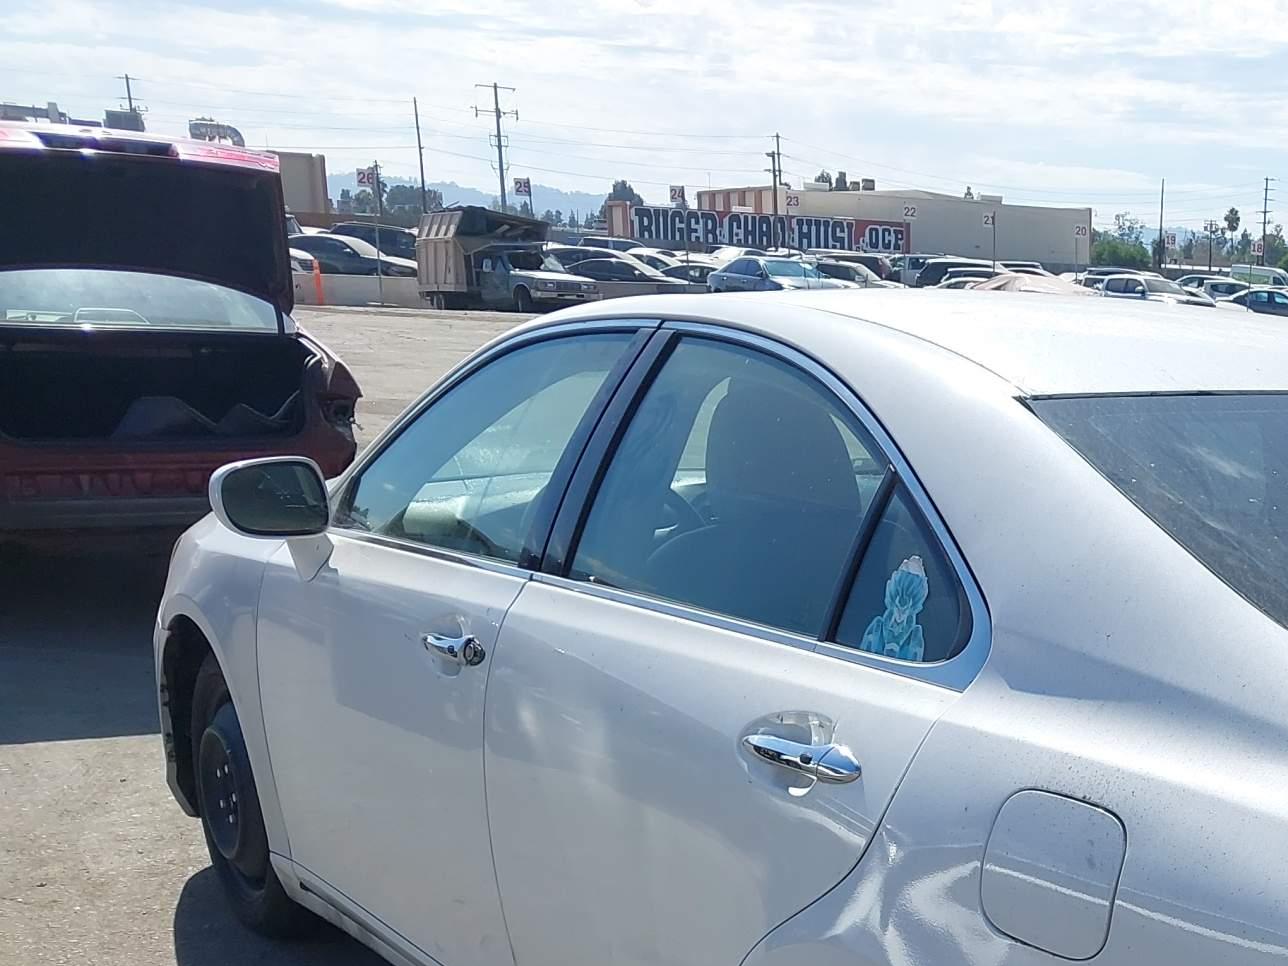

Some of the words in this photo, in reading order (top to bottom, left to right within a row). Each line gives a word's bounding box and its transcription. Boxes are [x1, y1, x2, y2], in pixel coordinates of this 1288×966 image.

[357, 171, 375, 184] 26
[515, 181, 531, 193] 25
[670, 188, 685, 200] 24
[786, 196, 800, 207] 23
[904, 206, 917, 217] 22
[984, 215, 995, 226] 21
[1074, 226, 1087, 236] 20
[1251, 243, 1263, 253] 18
